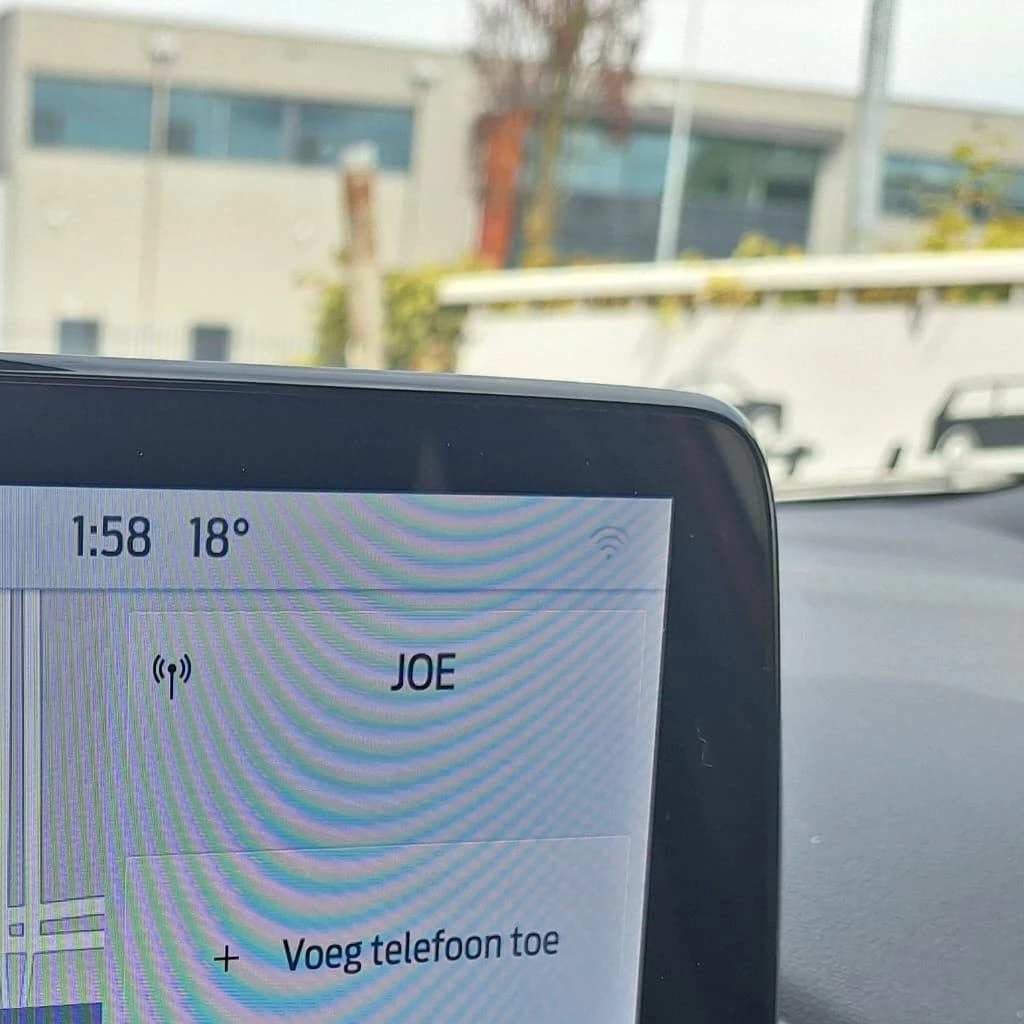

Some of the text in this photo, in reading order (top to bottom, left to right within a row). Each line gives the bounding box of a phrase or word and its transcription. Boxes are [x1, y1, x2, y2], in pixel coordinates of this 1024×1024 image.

[72, 514, 152, 557] 1:58
[189, 516, 250, 557] 18°
[390, 651, 456, 692] JOE
[283, 926, 560, 974] Voeg telefoon toe
